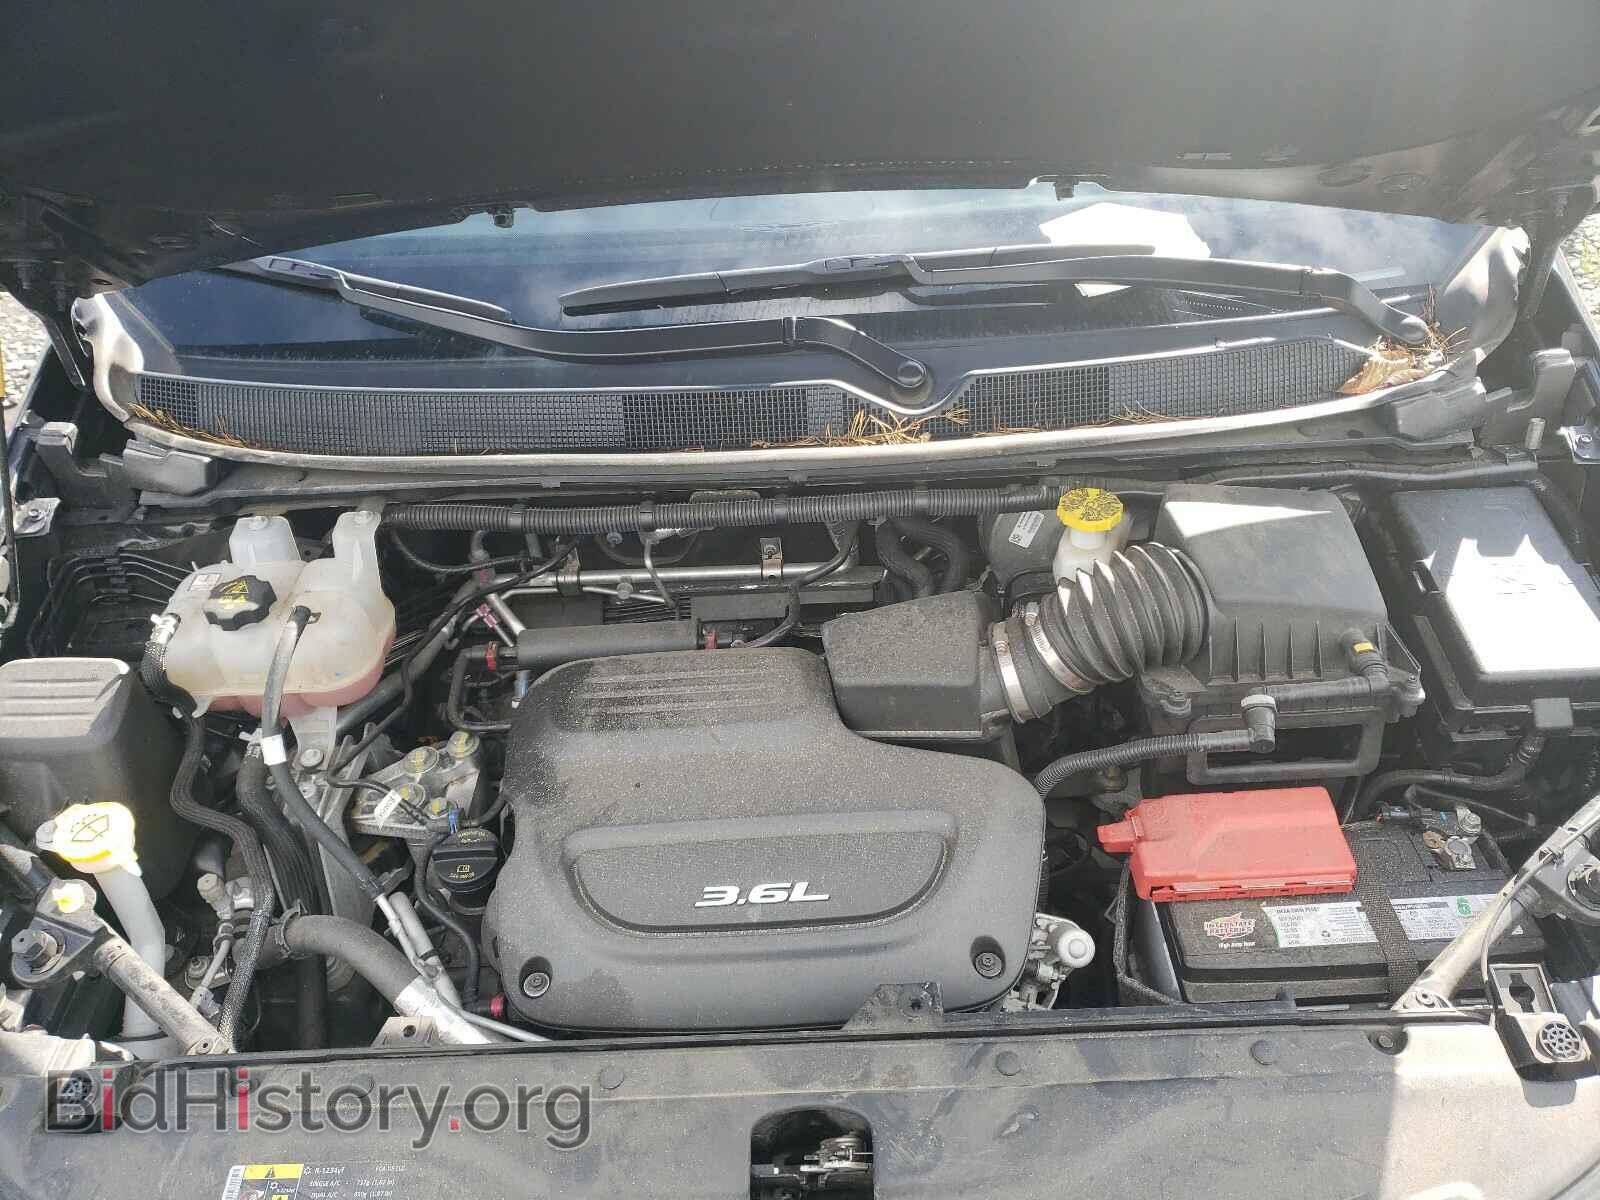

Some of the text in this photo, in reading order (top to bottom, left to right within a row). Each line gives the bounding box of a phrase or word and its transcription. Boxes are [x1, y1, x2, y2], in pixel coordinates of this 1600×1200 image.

[694, 881, 830, 907] 3.6L
[1203, 918, 1256, 930] INTERSTATE
[1207, 926, 1253, 937] BATTERIES
